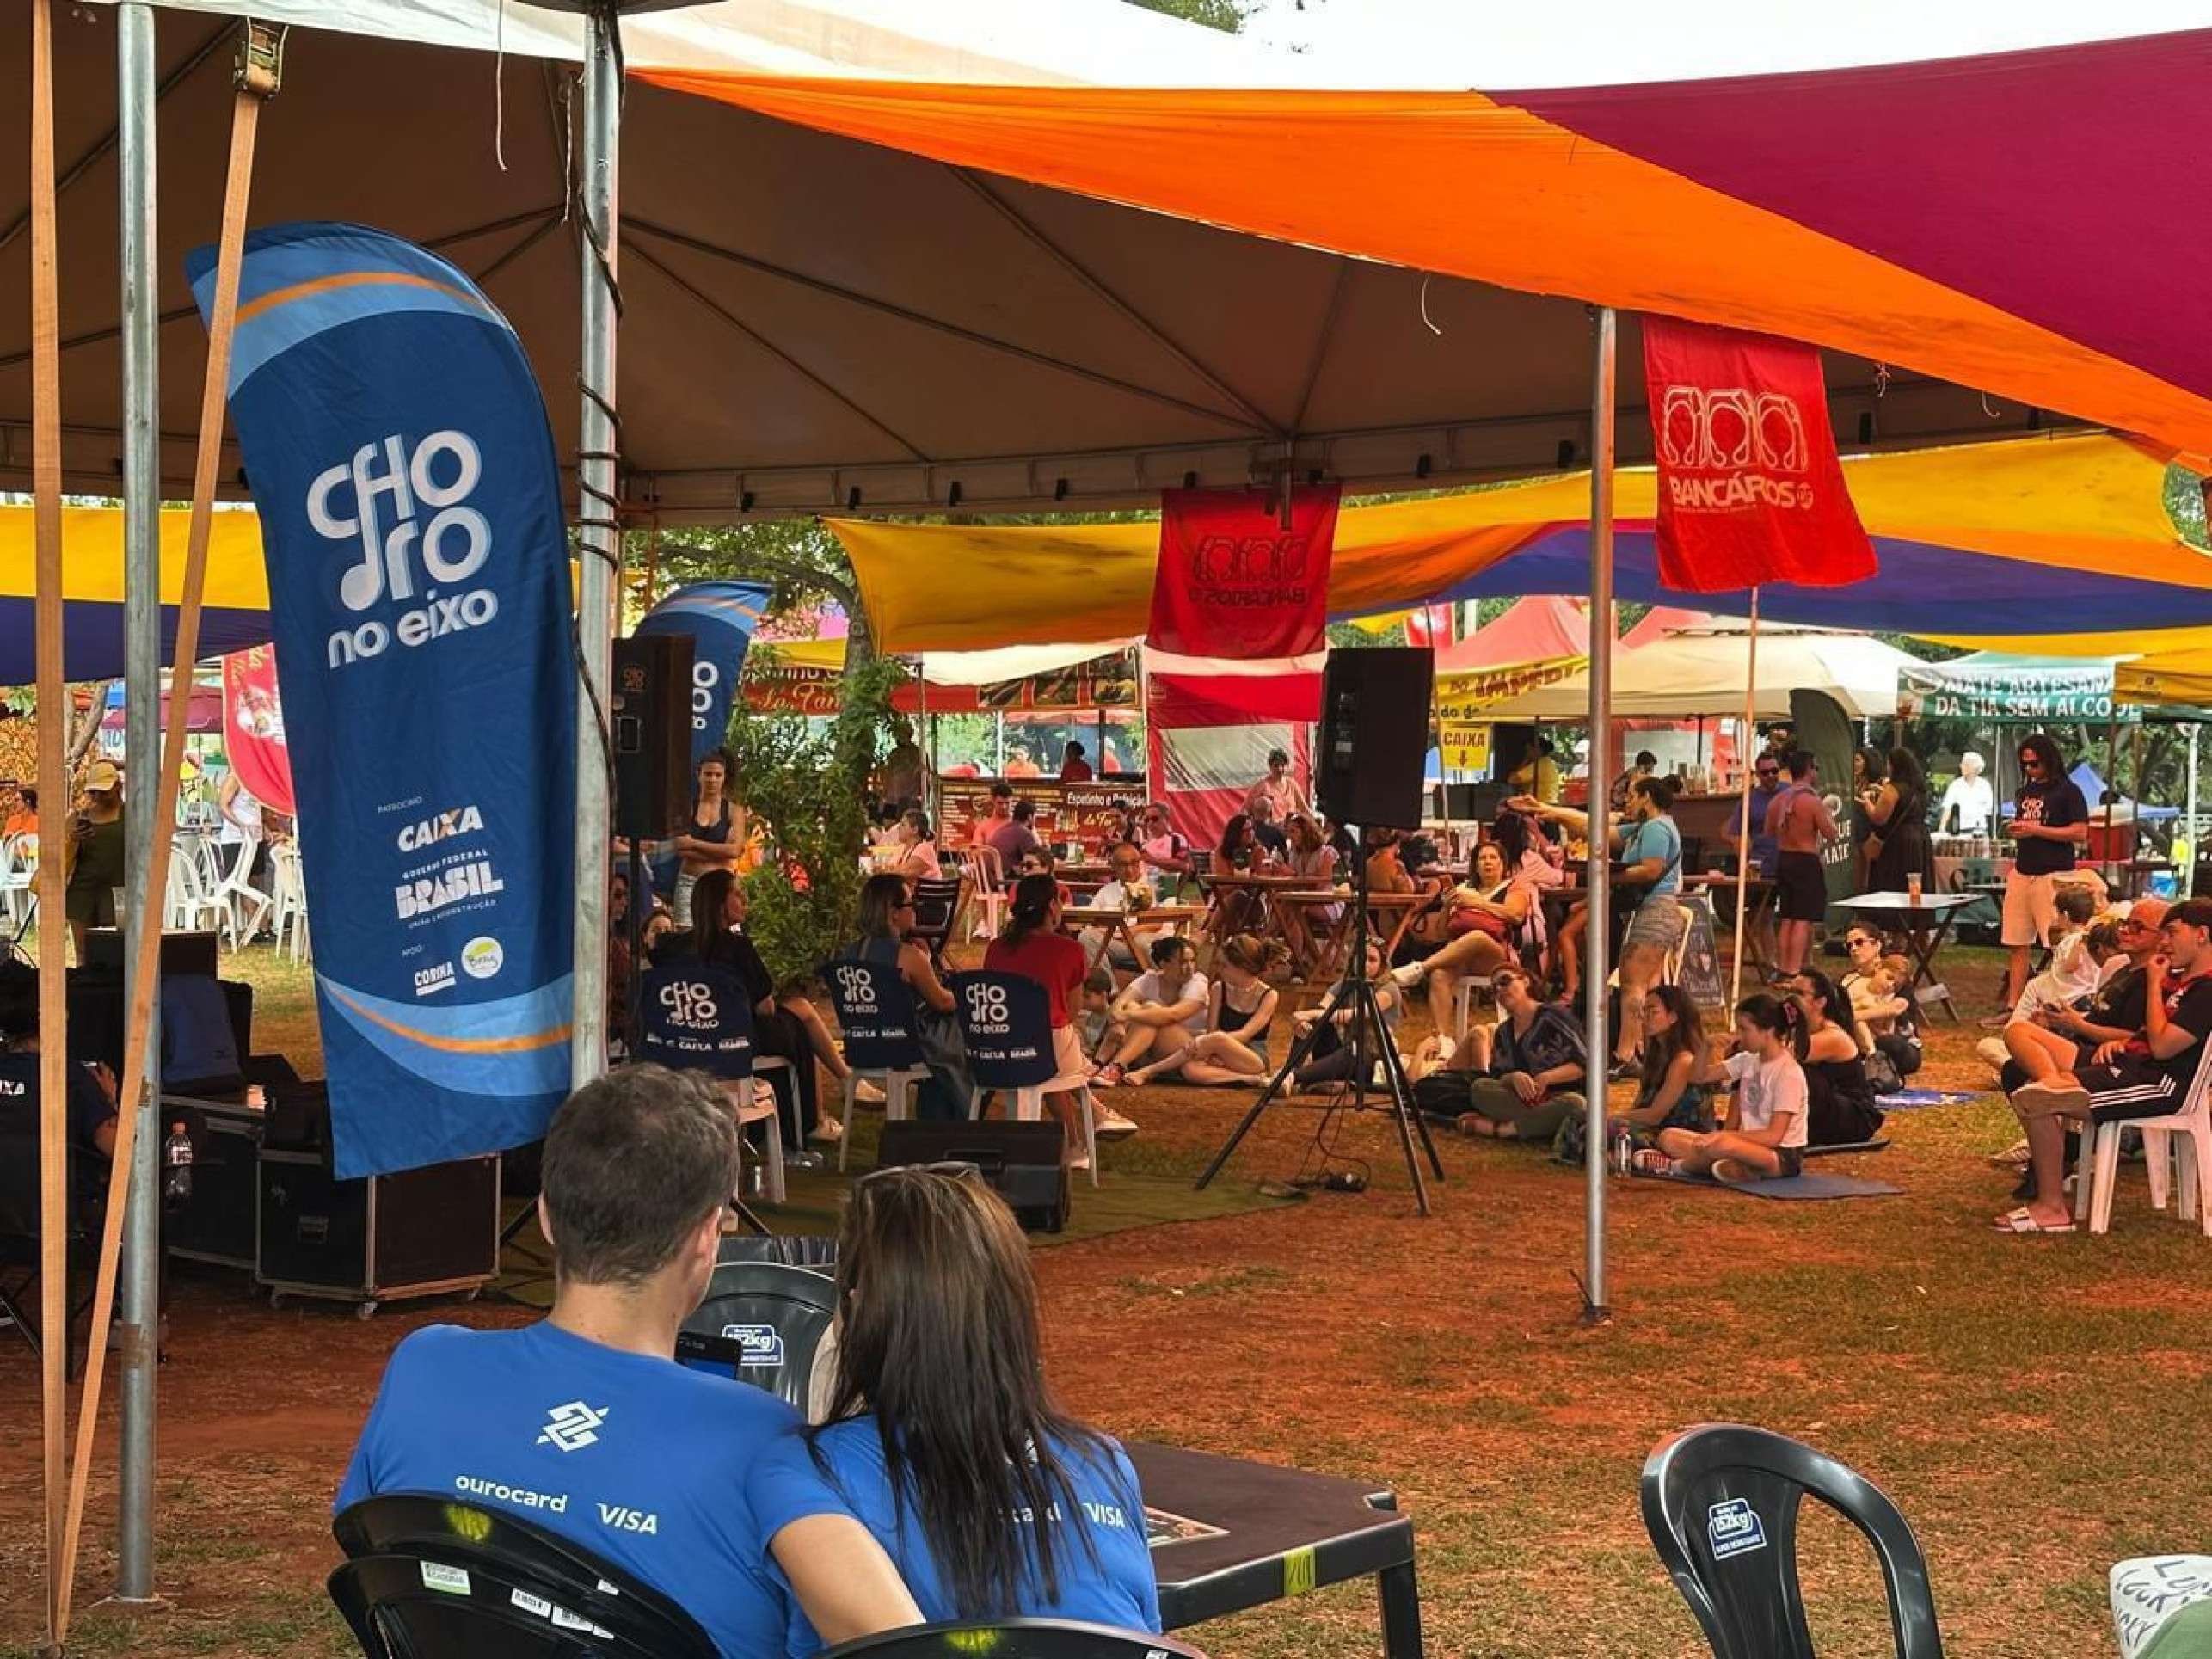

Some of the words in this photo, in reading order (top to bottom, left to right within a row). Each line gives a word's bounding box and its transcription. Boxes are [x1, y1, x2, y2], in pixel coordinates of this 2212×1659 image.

[328, 622, 389, 669] no
[397, 589, 498, 647] eixo
[1936, 697, 1961, 716] DA
[1969, 696, 2000, 716] TIA
[2006, 696, 2049, 716] SEM
[1444, 732, 1486, 747] CAIXA
[397, 805, 483, 851] CAIXA
[395, 861, 504, 919] BRASIL
[455, 1474, 568, 1514] ourocard
[596, 1502, 658, 1535] VISA
[1083, 1502, 1125, 1528] VISA
